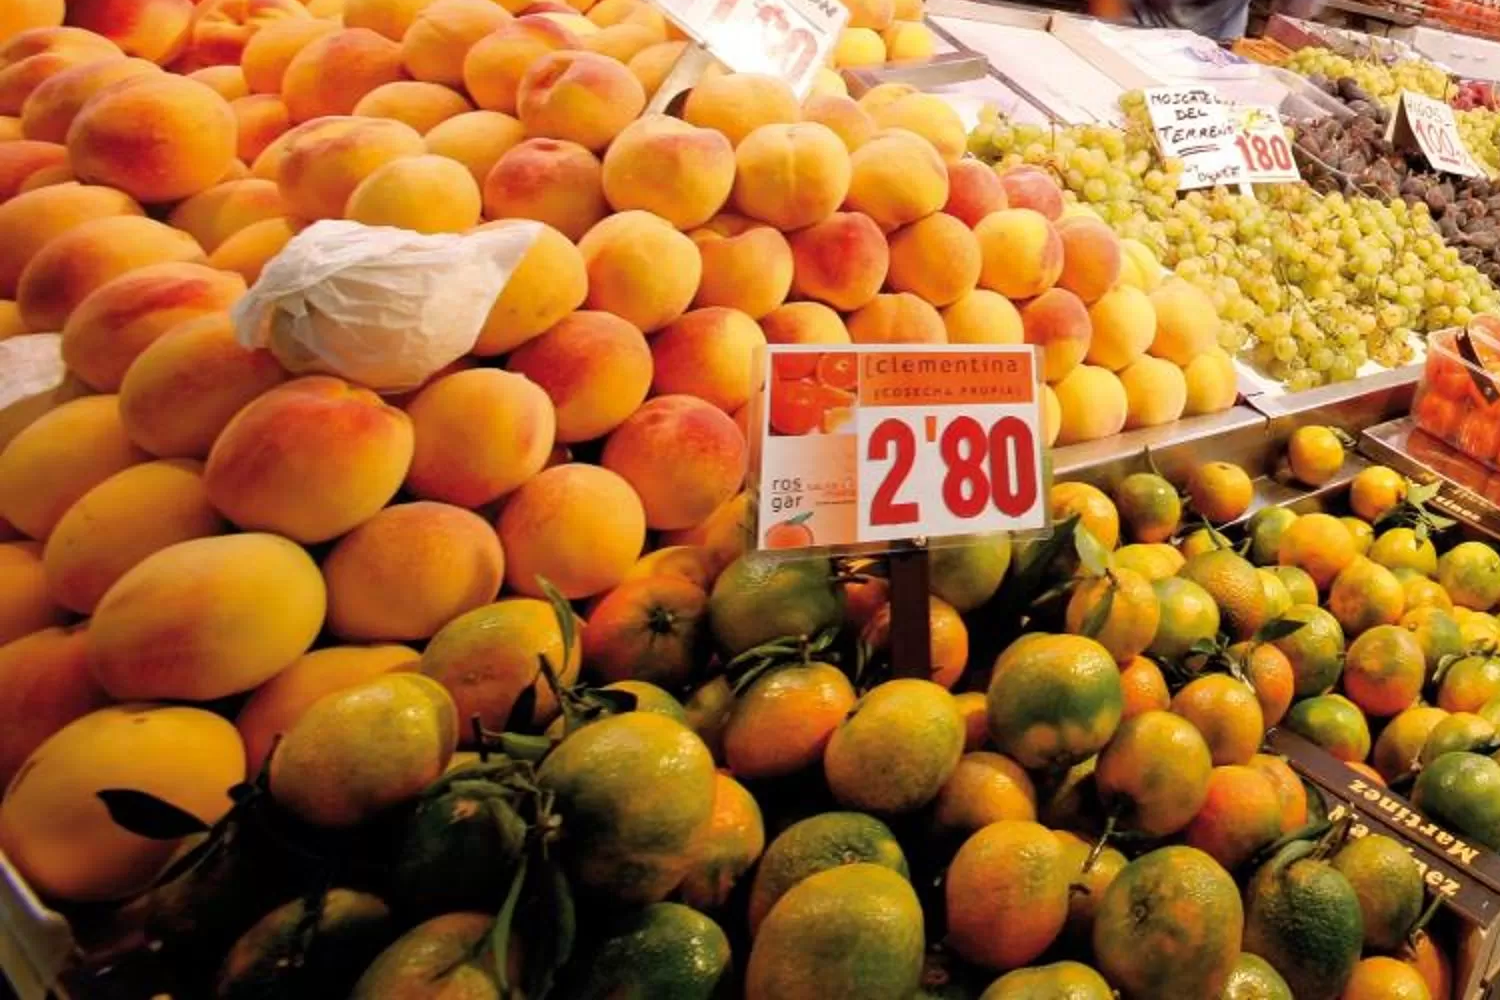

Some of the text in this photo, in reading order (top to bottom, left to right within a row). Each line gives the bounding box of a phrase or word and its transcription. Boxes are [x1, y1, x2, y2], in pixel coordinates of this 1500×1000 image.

[1174, 107, 1208, 121] DEL
[867, 415, 1038, 526] 2'80
[772, 478, 803, 492] ros
[771, 495, 804, 513] gar
[1348, 779, 1480, 865] Martinez
